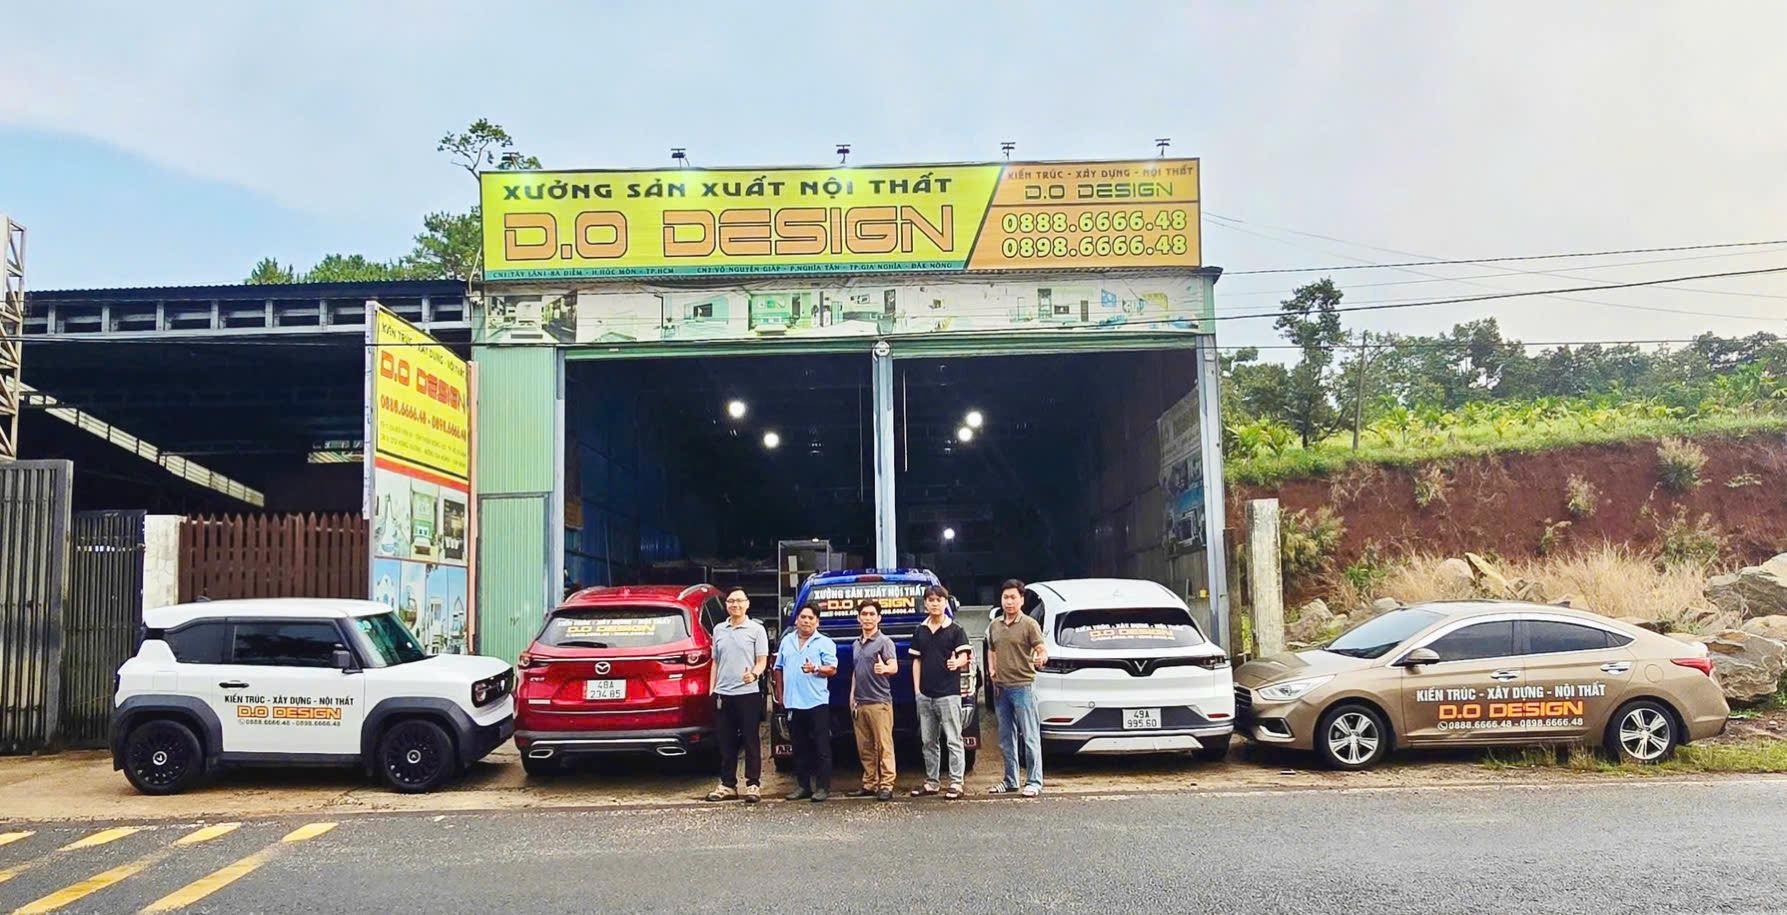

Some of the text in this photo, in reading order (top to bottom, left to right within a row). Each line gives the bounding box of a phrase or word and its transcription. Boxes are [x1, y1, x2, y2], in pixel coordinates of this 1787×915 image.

[1008, 167, 1031, 179] KIẾN
[1036, 167, 1063, 179] TRÚC
[1076, 168, 1096, 179] XÂY
[1101, 168, 1130, 179] DỰNG
[1143, 166, 1161, 177] NỘI
[1166, 164, 1193, 176] THẤT
[503, 172, 952, 200] XƯỞNG SẢN XUẤT NỘI THẤT
[1025, 181, 1173, 200] D.O DESIGN
[1001, 209, 1187, 234] 0888.6666.48
[504, 205, 954, 261] D.O DESIGN
[1001, 234, 1188, 258] 0898.6666.48
[381, 350, 466, 414] D.O DESIGN
[814, 583, 925, 600] XƯỞNG SẢN XUẤT NỘI THẤT
[827, 600, 853, 610] D.O
[567, 624, 656, 633] D.O DESIGN
[1089, 628, 1175, 637] D.O DESIGN
[224, 693, 243, 703] KIẾN
[245, 693, 265, 704] TRÚC
[273, 693, 289, 704] XÂY
[290, 695, 311, 706] DỰNG
[319, 695, 333, 706] NỘI
[335, 695, 354, 706] THẤT
[1416, 687, 1443, 702] KIẾN
[1447, 686, 1476, 701] TRÚC
[1487, 685, 1510, 700] XÂY
[1512, 686, 1544, 702] DỰNG
[1555, 684, 1575, 699] NỘI
[1578, 680, 1606, 697] THẤT
[237, 705, 342, 720] D.O DESIGN
[1133, 710, 1150, 719] 49A
[1438, 700, 1584, 719] D.O DESIGN
[1449, 719, 1512, 730] 0888.6666.48
[1520, 717, 1583, 728] 0898.6666.48
